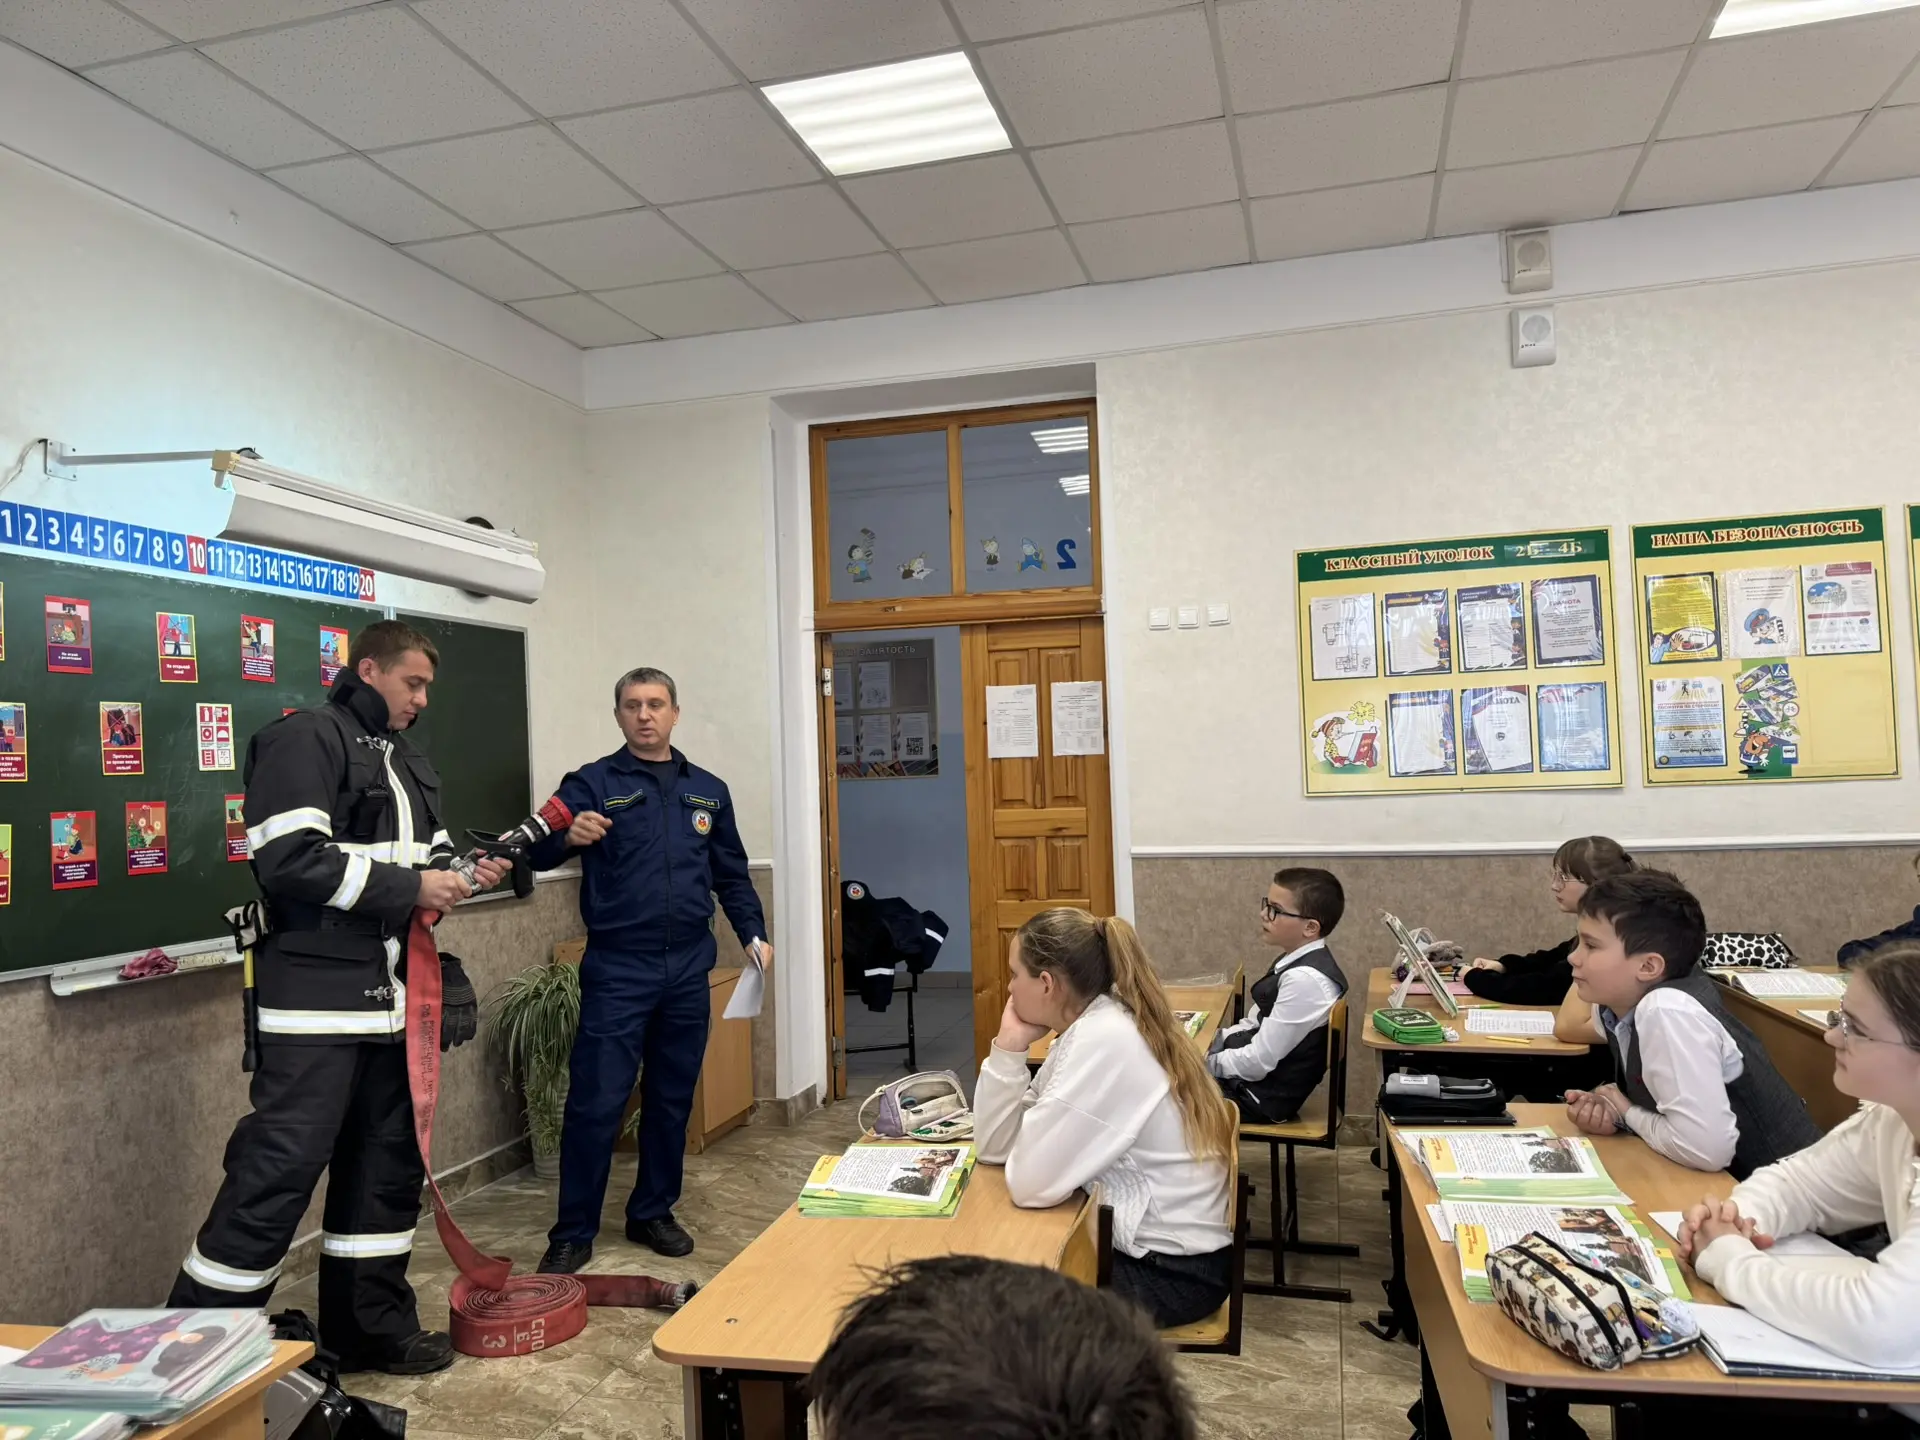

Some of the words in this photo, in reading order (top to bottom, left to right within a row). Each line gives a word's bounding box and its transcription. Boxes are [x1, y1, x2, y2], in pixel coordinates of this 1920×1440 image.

[1652, 532, 1711, 548] НАША
[1712, 519, 1864, 543] БЕЗОПАСНОСТЬ
[1, 509, 12, 538] 1
[24, 513, 38, 542] 2
[48, 517, 60, 545] 3
[70, 522, 84, 549] 4
[93, 525, 104, 552] 5
[113, 529, 126, 556] 6
[133, 532, 144, 559] 7
[153, 536, 165, 563] 8
[172, 539, 184, 564] 9
[190, 542, 205, 569] 10
[208, 546, 223, 572] 11
[228, 549, 245, 575] 12
[248, 553, 262, 578] 13
[264, 557, 279, 582] 14
[281, 560, 296, 584] 15
[298, 563, 312, 587] 16
[314, 566, 329, 589] 17
[331, 569, 345, 592] 18
[348, 571, 359, 594] 19
[359, 574, 373, 597] 20
[1325, 549, 1420, 572] КЛАССНЫЙ
[1423, 546, 1494, 564] УГОЛОК
[1558, 542, 1582, 554] 4Б
[860, 646, 916, 657] ЗАНЯТОСТЬ
[482, 1335, 506, 1348] 3
[531, 1318, 544, 1351] СПО
